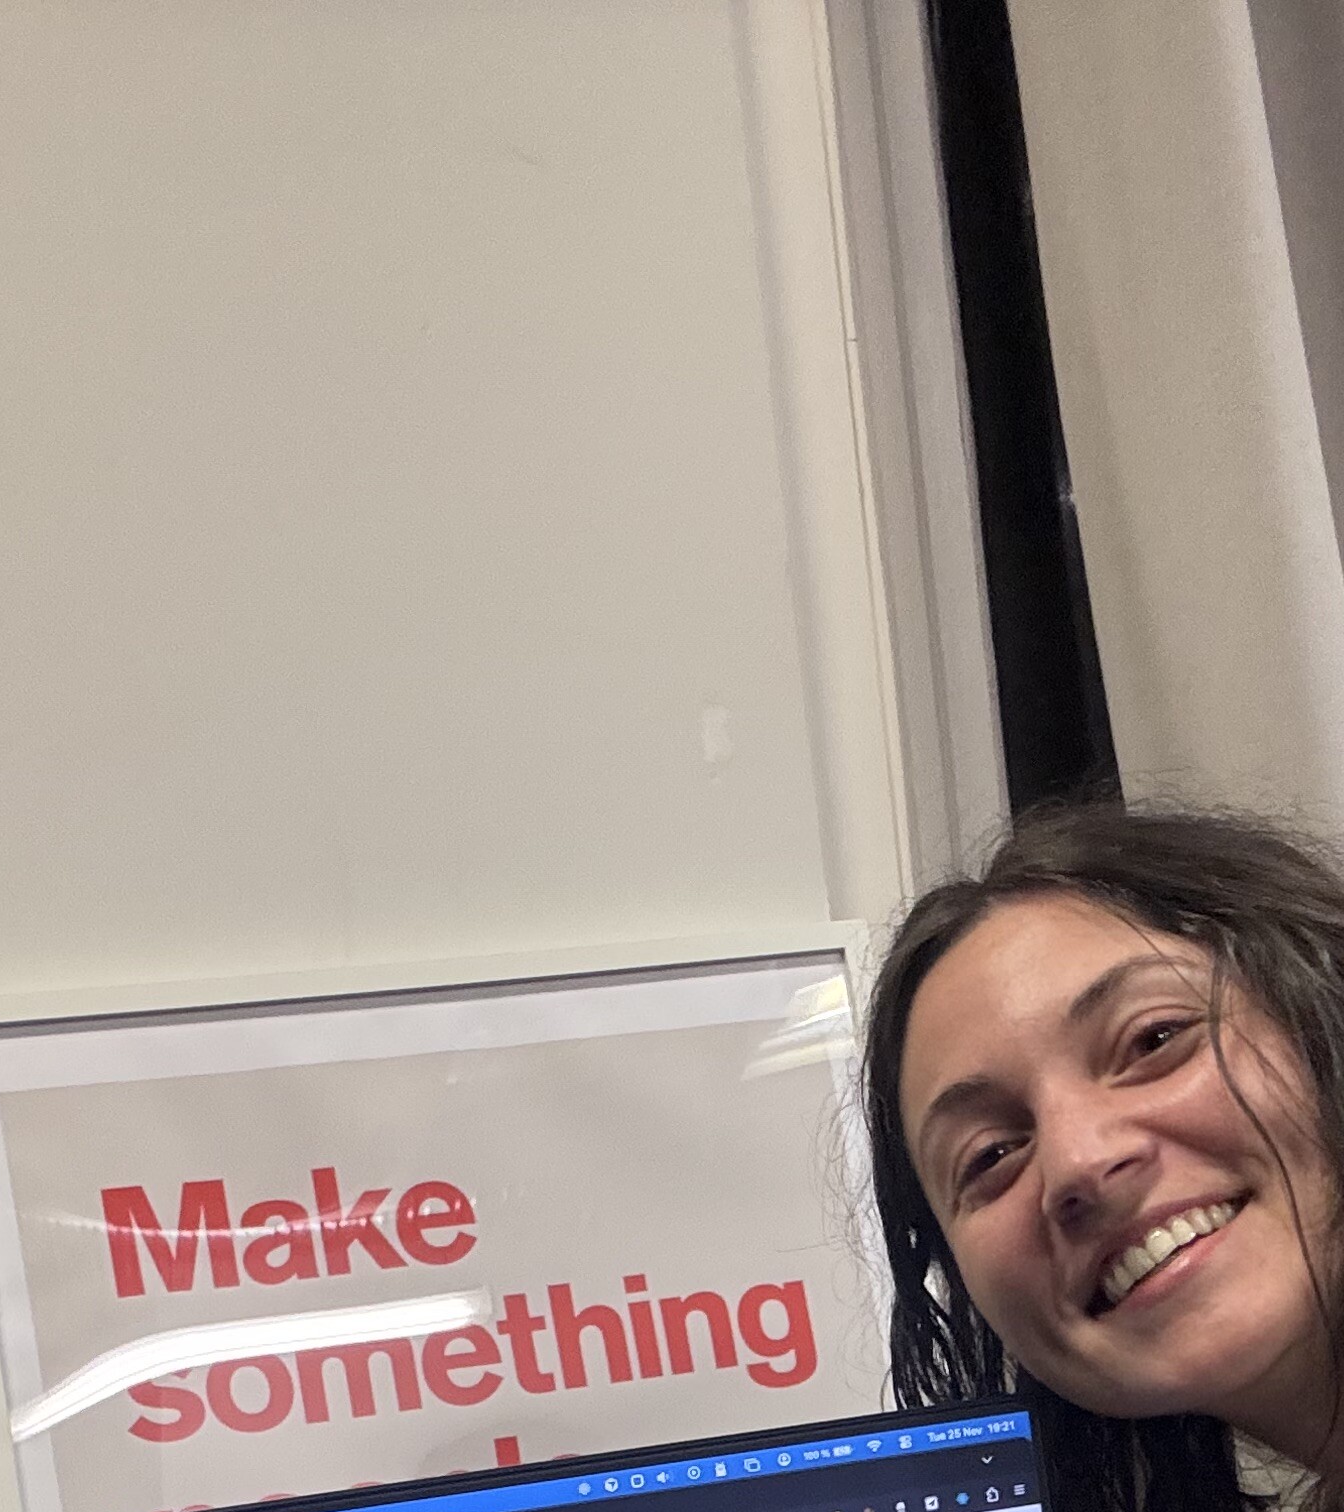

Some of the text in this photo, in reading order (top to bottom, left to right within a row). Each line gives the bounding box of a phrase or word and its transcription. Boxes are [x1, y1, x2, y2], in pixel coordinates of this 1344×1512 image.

[99, 1167, 479, 1298] Make
[126, 1273, 820, 1443] something
[927, 1431, 946, 1443] Tue
[947, 1428, 961, 1440] 25
[962, 1426, 982, 1438] Nov
